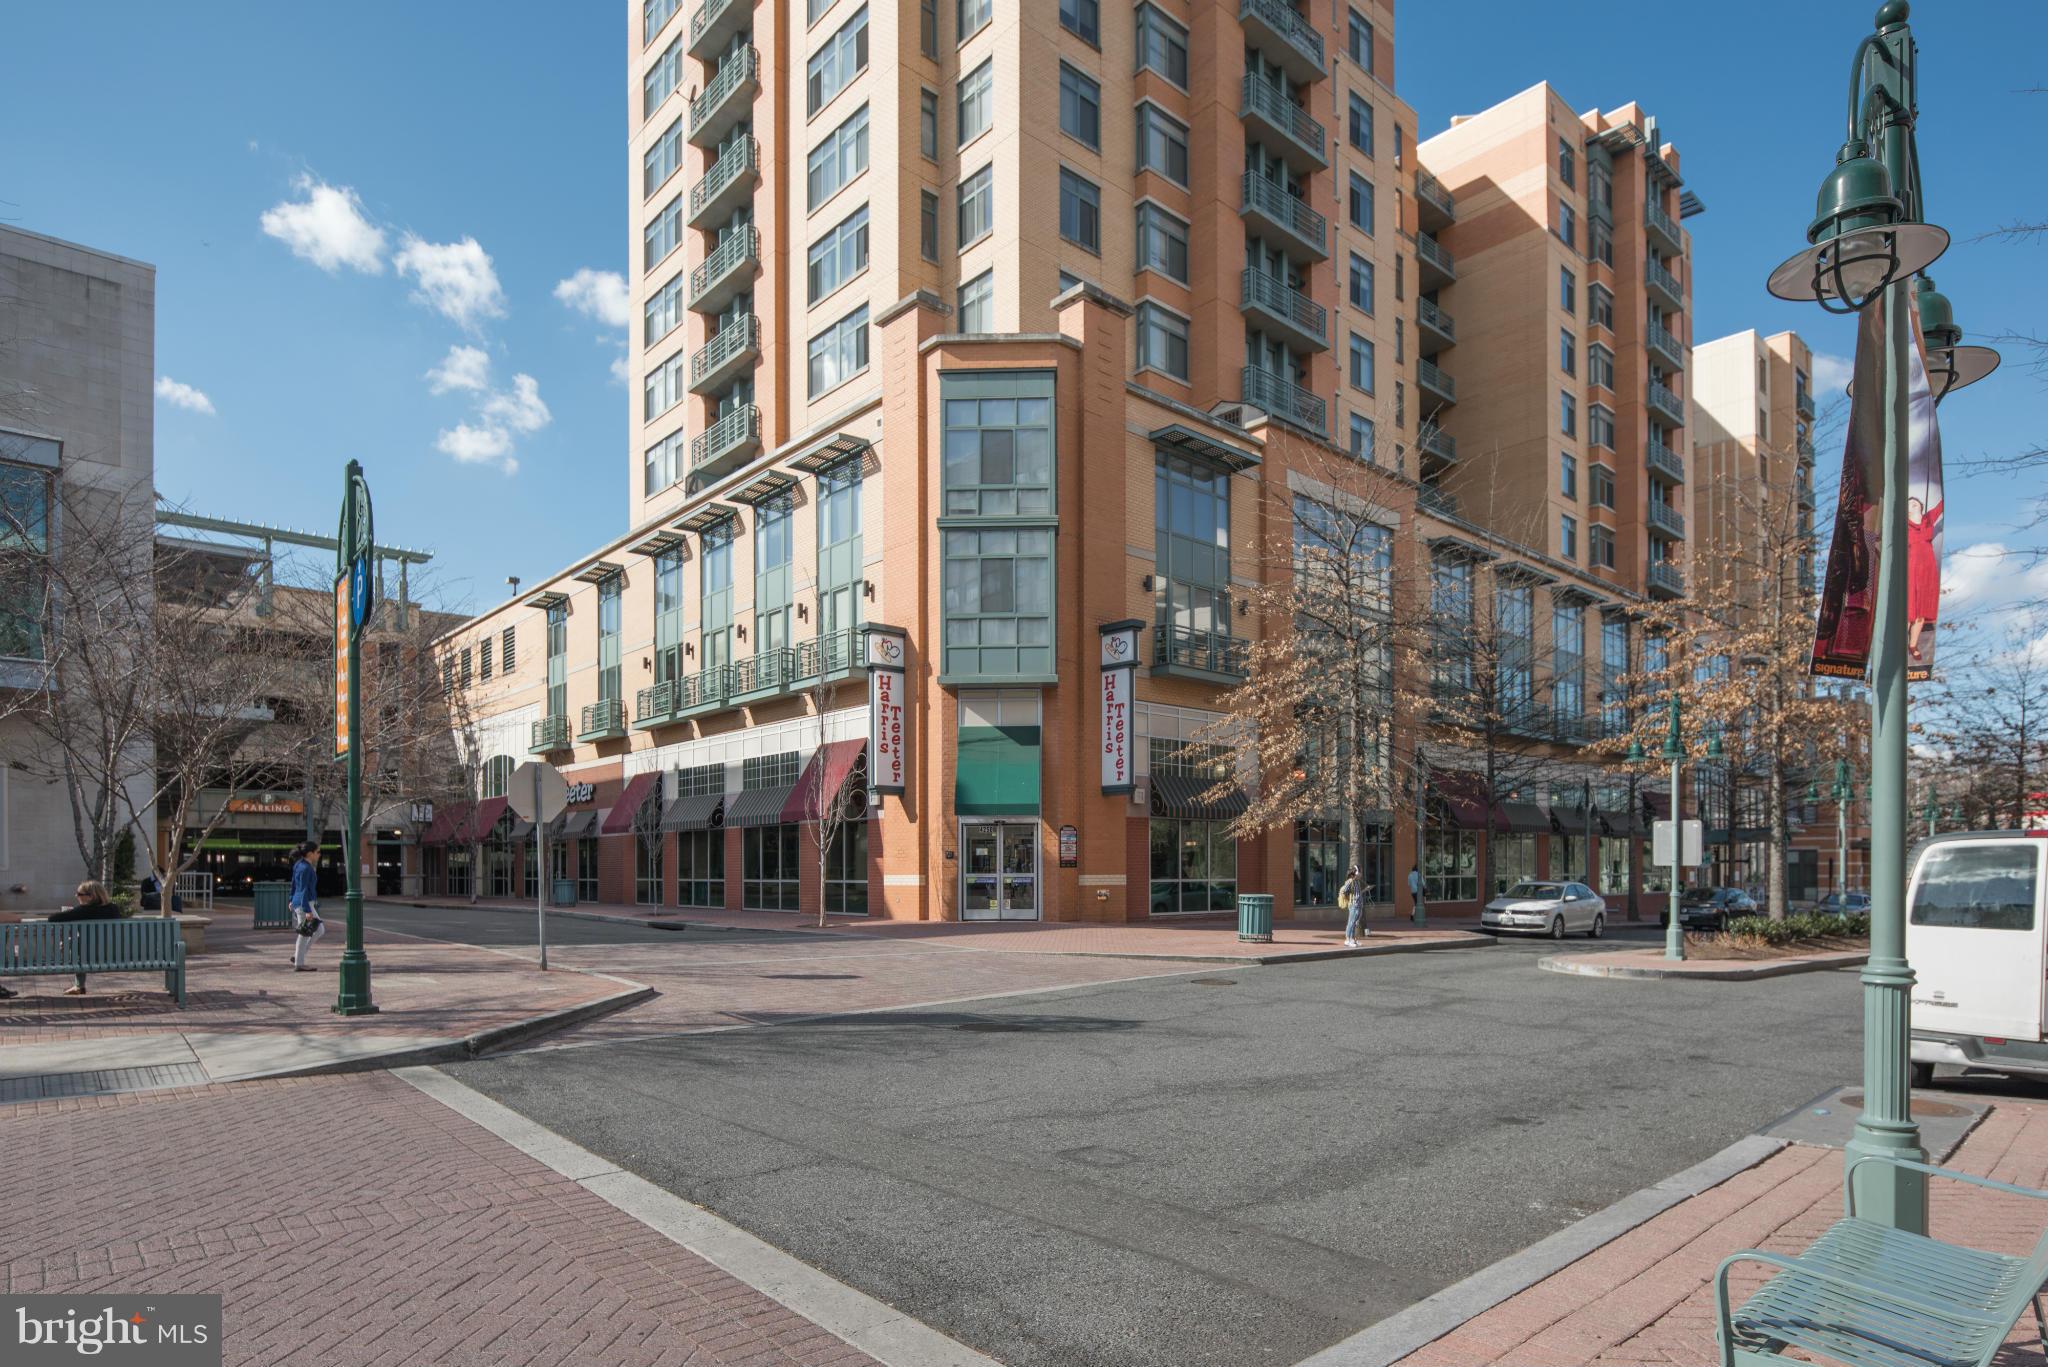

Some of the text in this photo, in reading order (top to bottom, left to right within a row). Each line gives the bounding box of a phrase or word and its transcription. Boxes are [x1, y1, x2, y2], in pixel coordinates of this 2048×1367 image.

[356, 575, 363, 608] P
[1815, 663, 1864, 677] signature
[878, 674, 892, 754] Harris
[890, 706, 901, 783] Teeter
[1104, 674, 1116, 754] Harris
[1114, 703, 1125, 781] Teeter
[243, 803, 291, 812] PARKING
